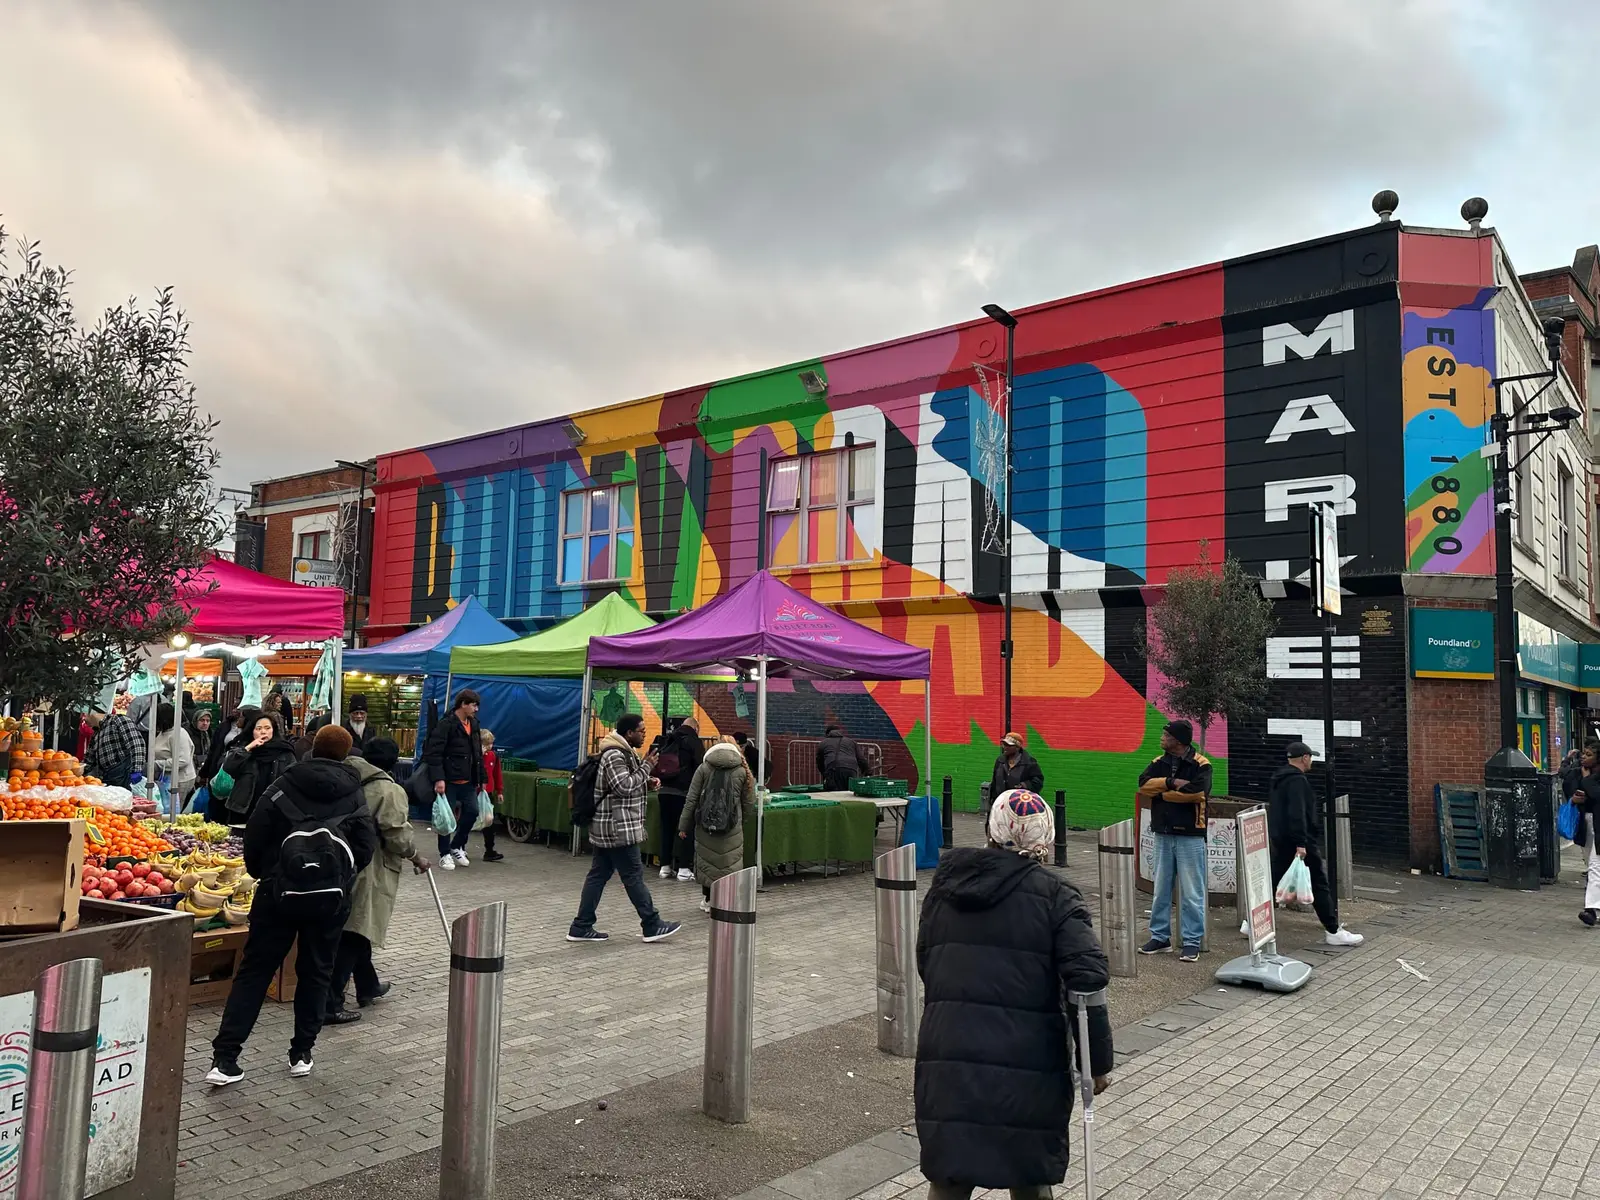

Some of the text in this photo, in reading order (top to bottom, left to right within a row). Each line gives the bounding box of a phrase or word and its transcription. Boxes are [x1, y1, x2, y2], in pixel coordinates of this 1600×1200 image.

[1426, 327, 1462, 555] EST. 1880
[1428, 637, 1470, 648] Poundland
[98, 1062, 133, 1086] AD
